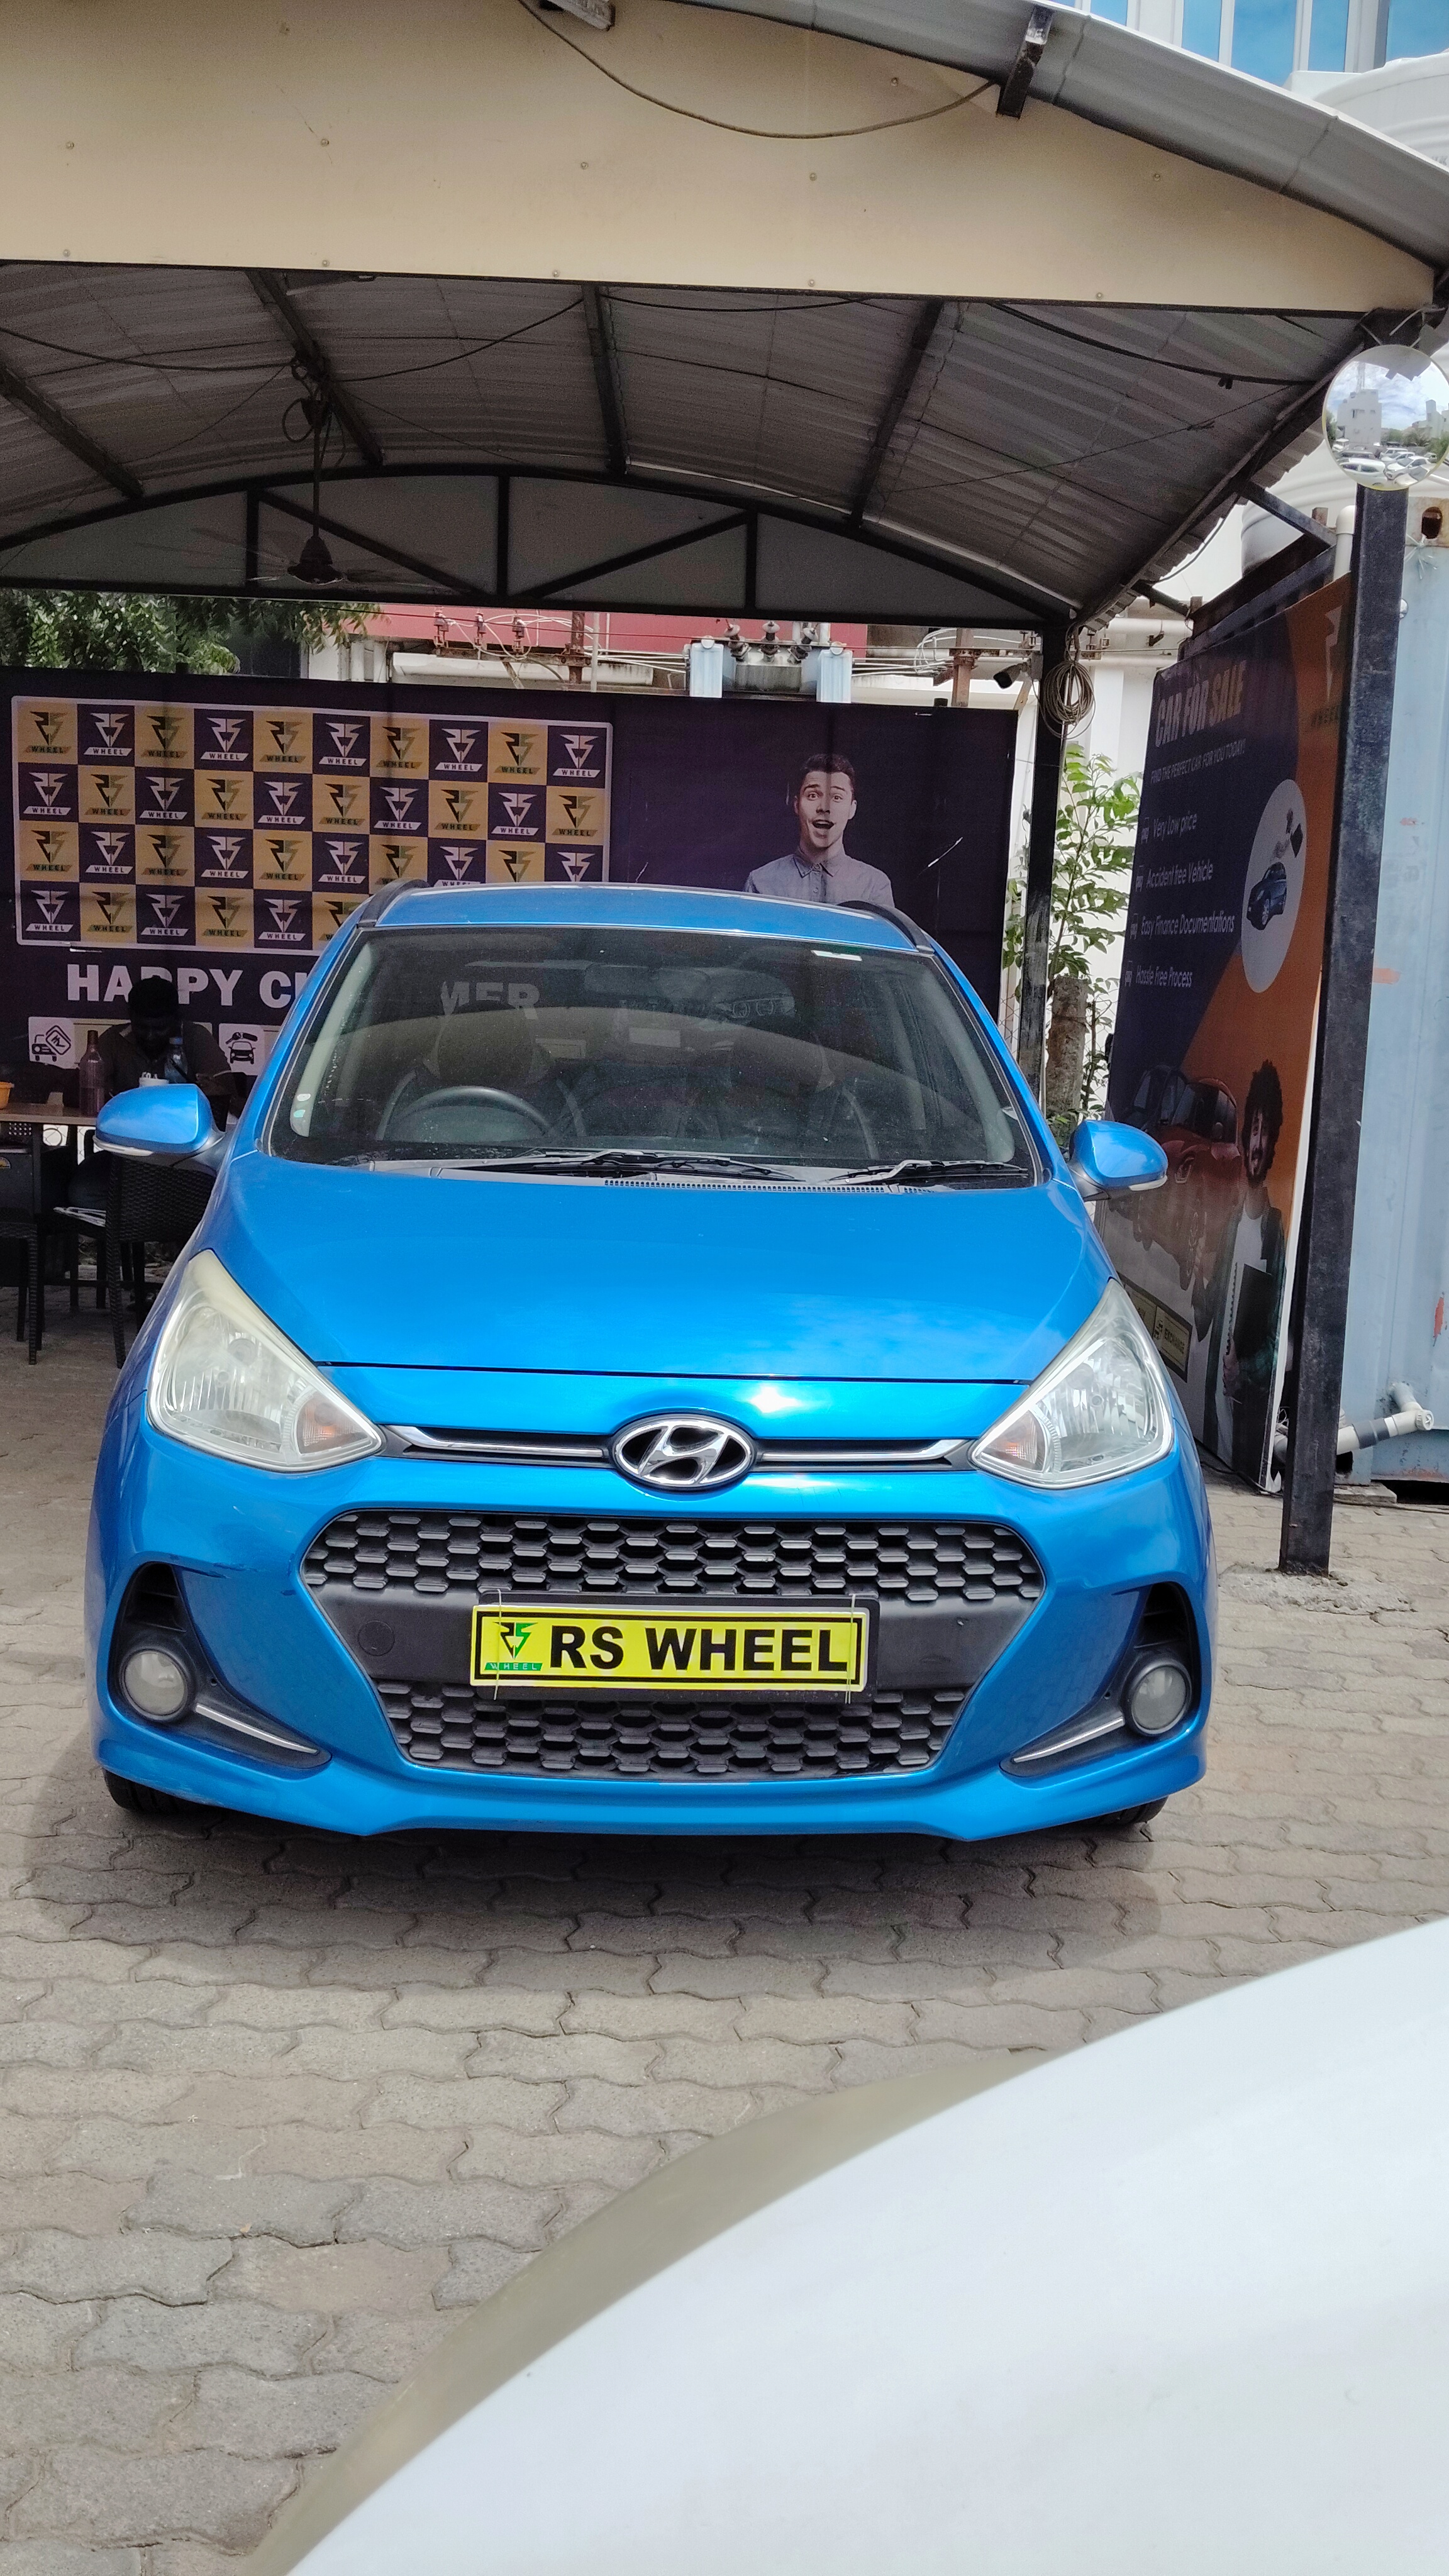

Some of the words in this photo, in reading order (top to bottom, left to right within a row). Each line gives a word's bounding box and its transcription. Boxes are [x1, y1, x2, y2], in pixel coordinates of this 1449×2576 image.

[1155, 692, 1182, 747] CAR
[1182, 679, 1209, 737] FOR
[1209, 660, 1246, 726] SALE
[1153, 818, 1165, 841] Very
[1167, 816, 1179, 835] Low
[1188, 859, 1214, 883] Vehicle
[1141, 916, 1154, 940] Easy
[1155, 915, 1178, 935] Finance
[1179, 910, 1235, 934] Documentations
[1168, 967, 1193, 988] Process
[550, 1624, 624, 1670] RS
[645, 1627, 848, 1672] WHEEL
[490, 1662, 538, 1671] WHEEL
